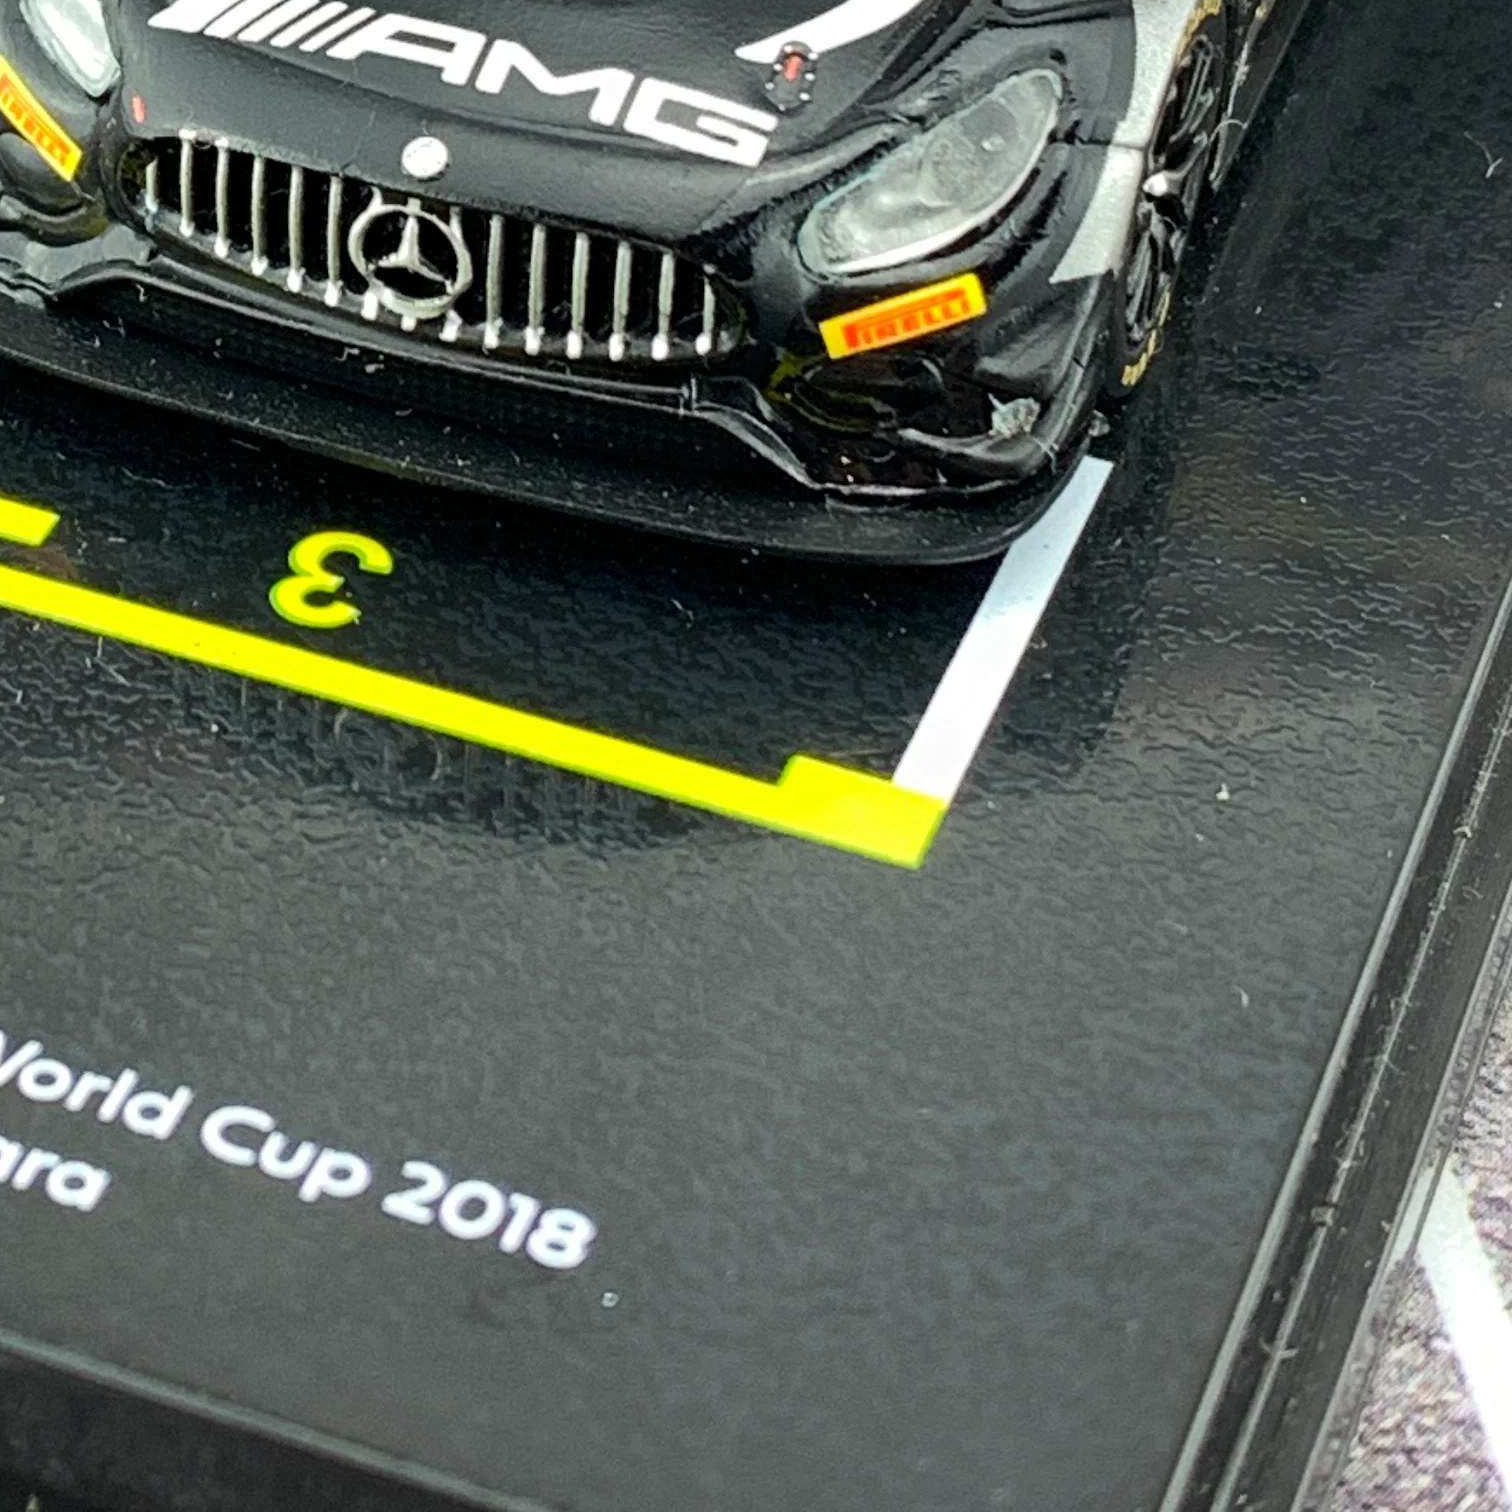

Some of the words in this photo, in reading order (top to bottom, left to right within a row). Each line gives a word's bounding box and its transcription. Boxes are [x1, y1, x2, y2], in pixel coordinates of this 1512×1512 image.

[325, 12, 779, 168] AMG
[839, 287, 971, 350] PIRELLI
[268, 530, 394, 629] 3
[199, 1105, 372, 1202] Cup
[381, 1160, 597, 1269] 2018
